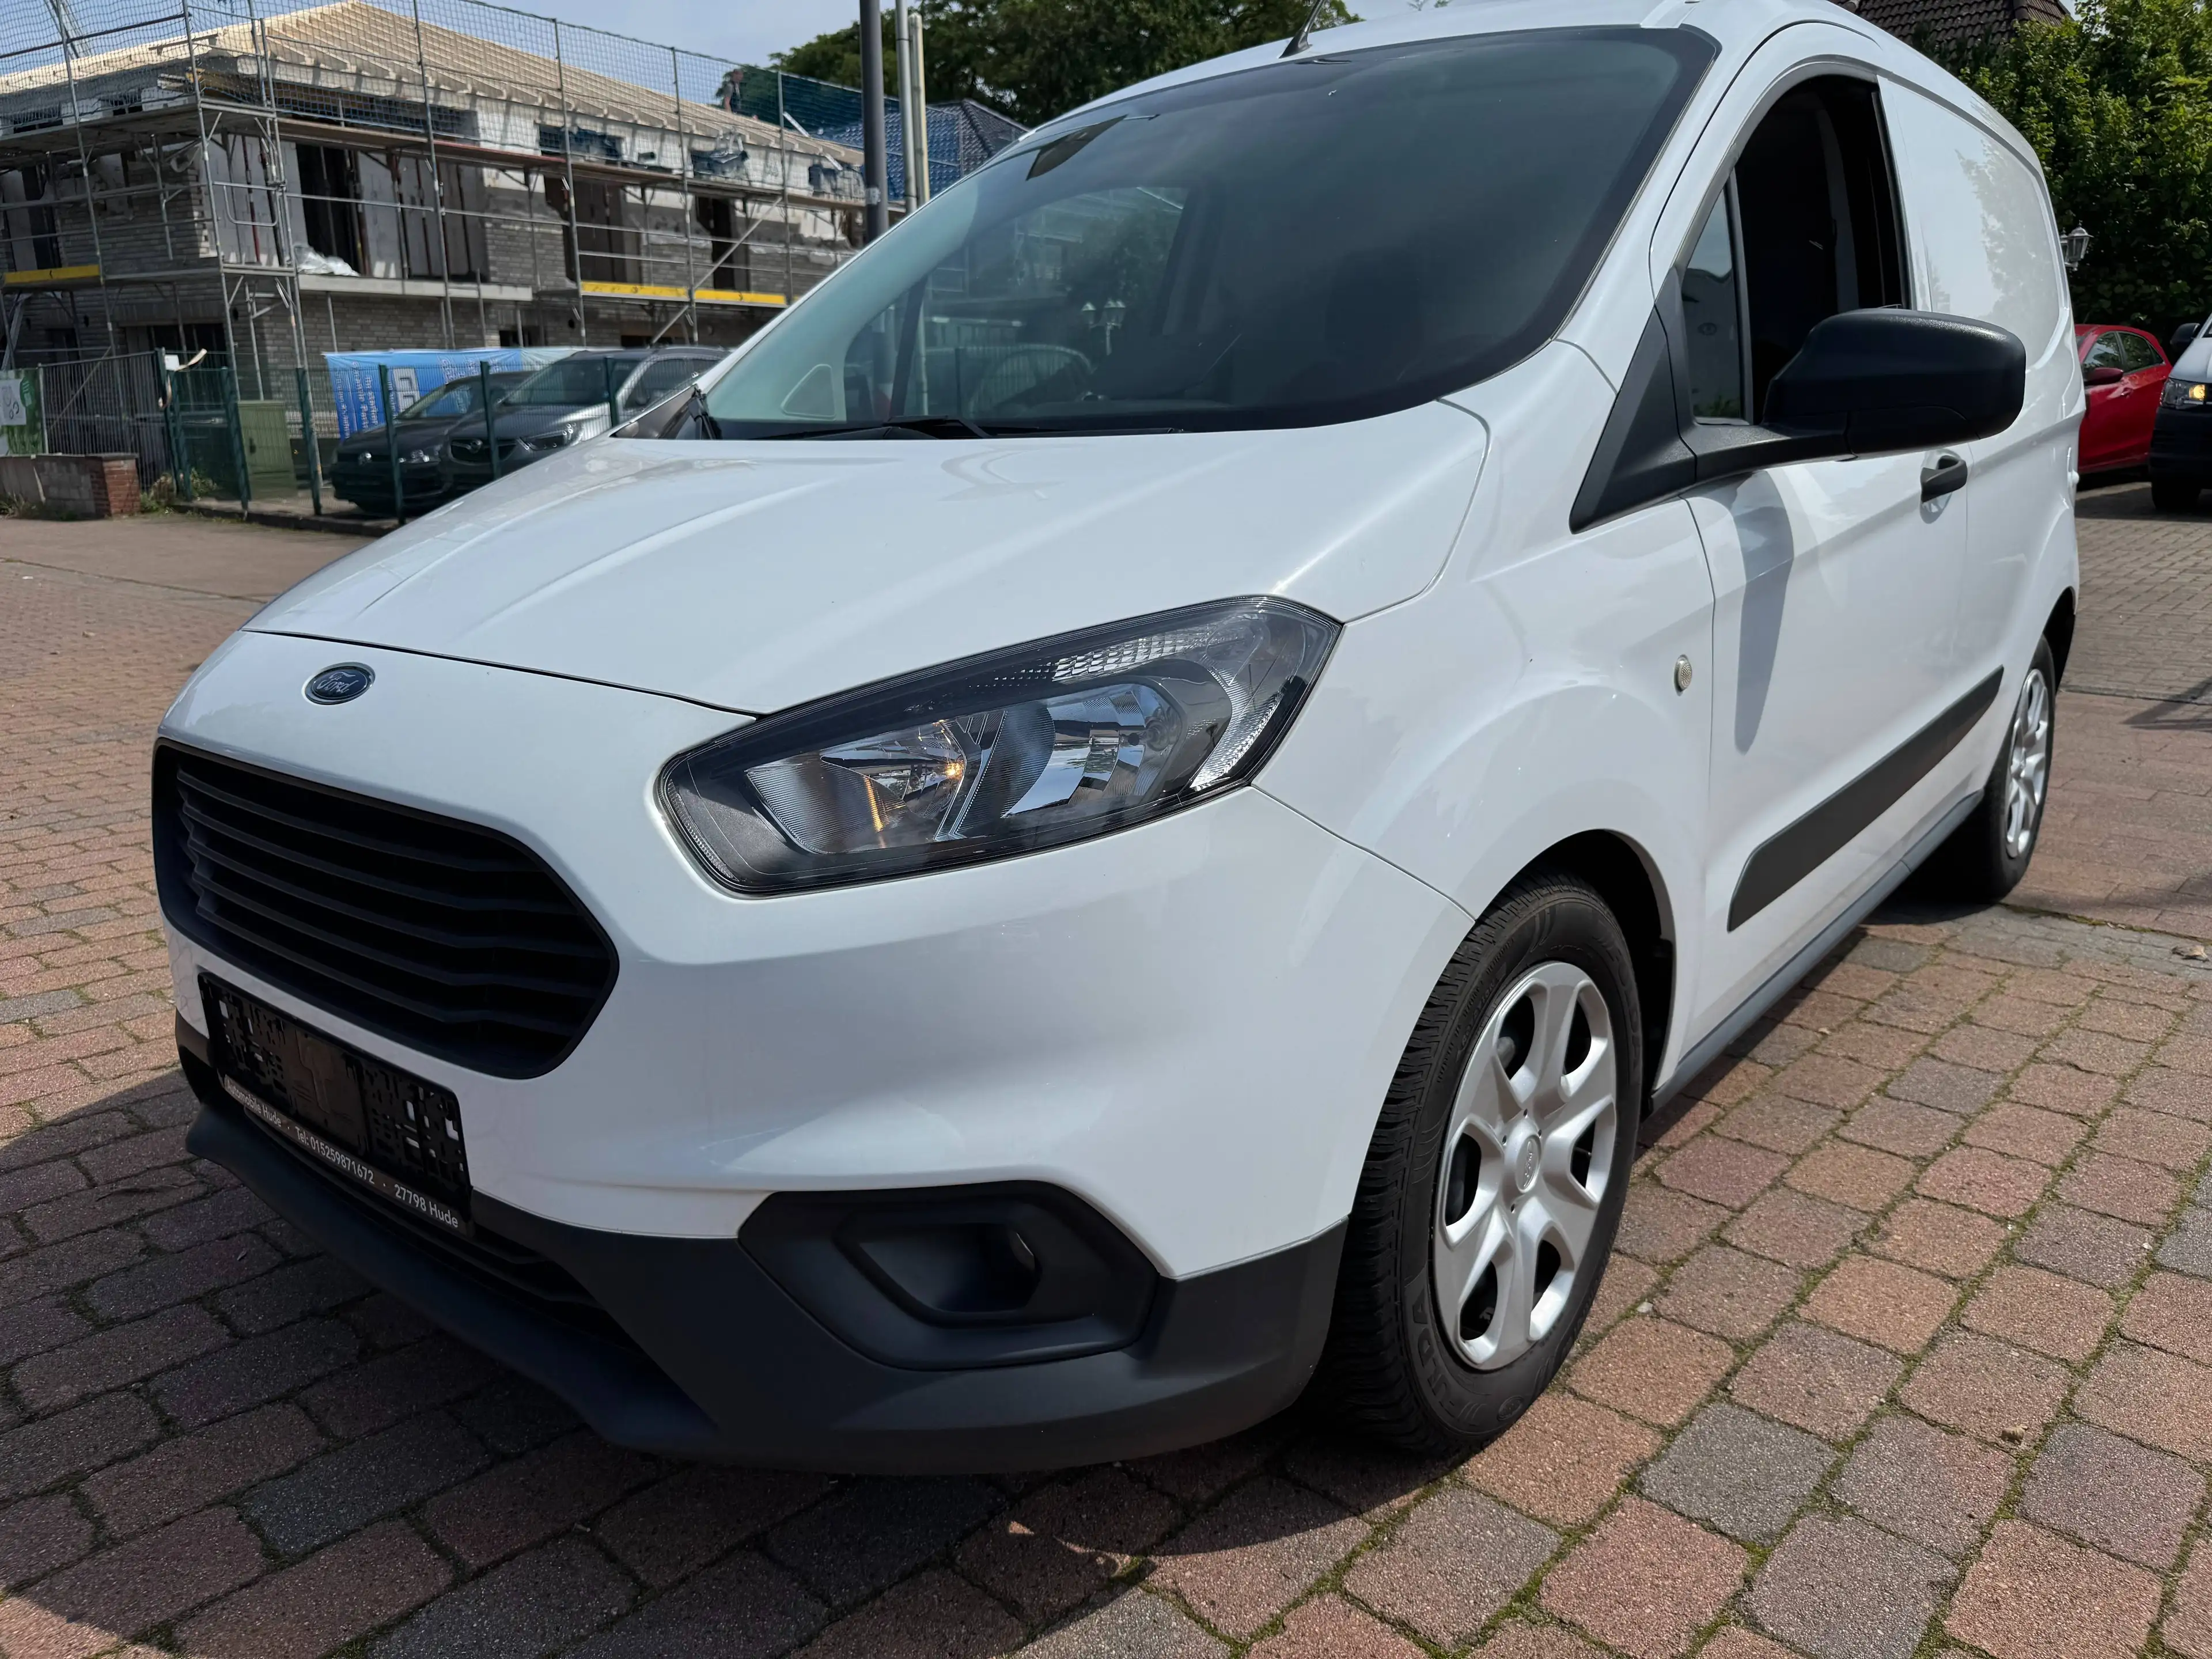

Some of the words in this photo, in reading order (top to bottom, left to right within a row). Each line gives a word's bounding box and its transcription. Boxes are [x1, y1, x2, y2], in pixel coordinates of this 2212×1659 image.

[317, 671, 359, 694] Ford
[226, 1079, 262, 1114] Automobile
[263, 1104, 282, 1127] Hude
[295, 1126, 309, 1146] Tel:
[310, 1137, 374, 1184] 015259871672
[395, 1184, 427, 1211] 27798
[429, 1201, 459, 1228] Hude
